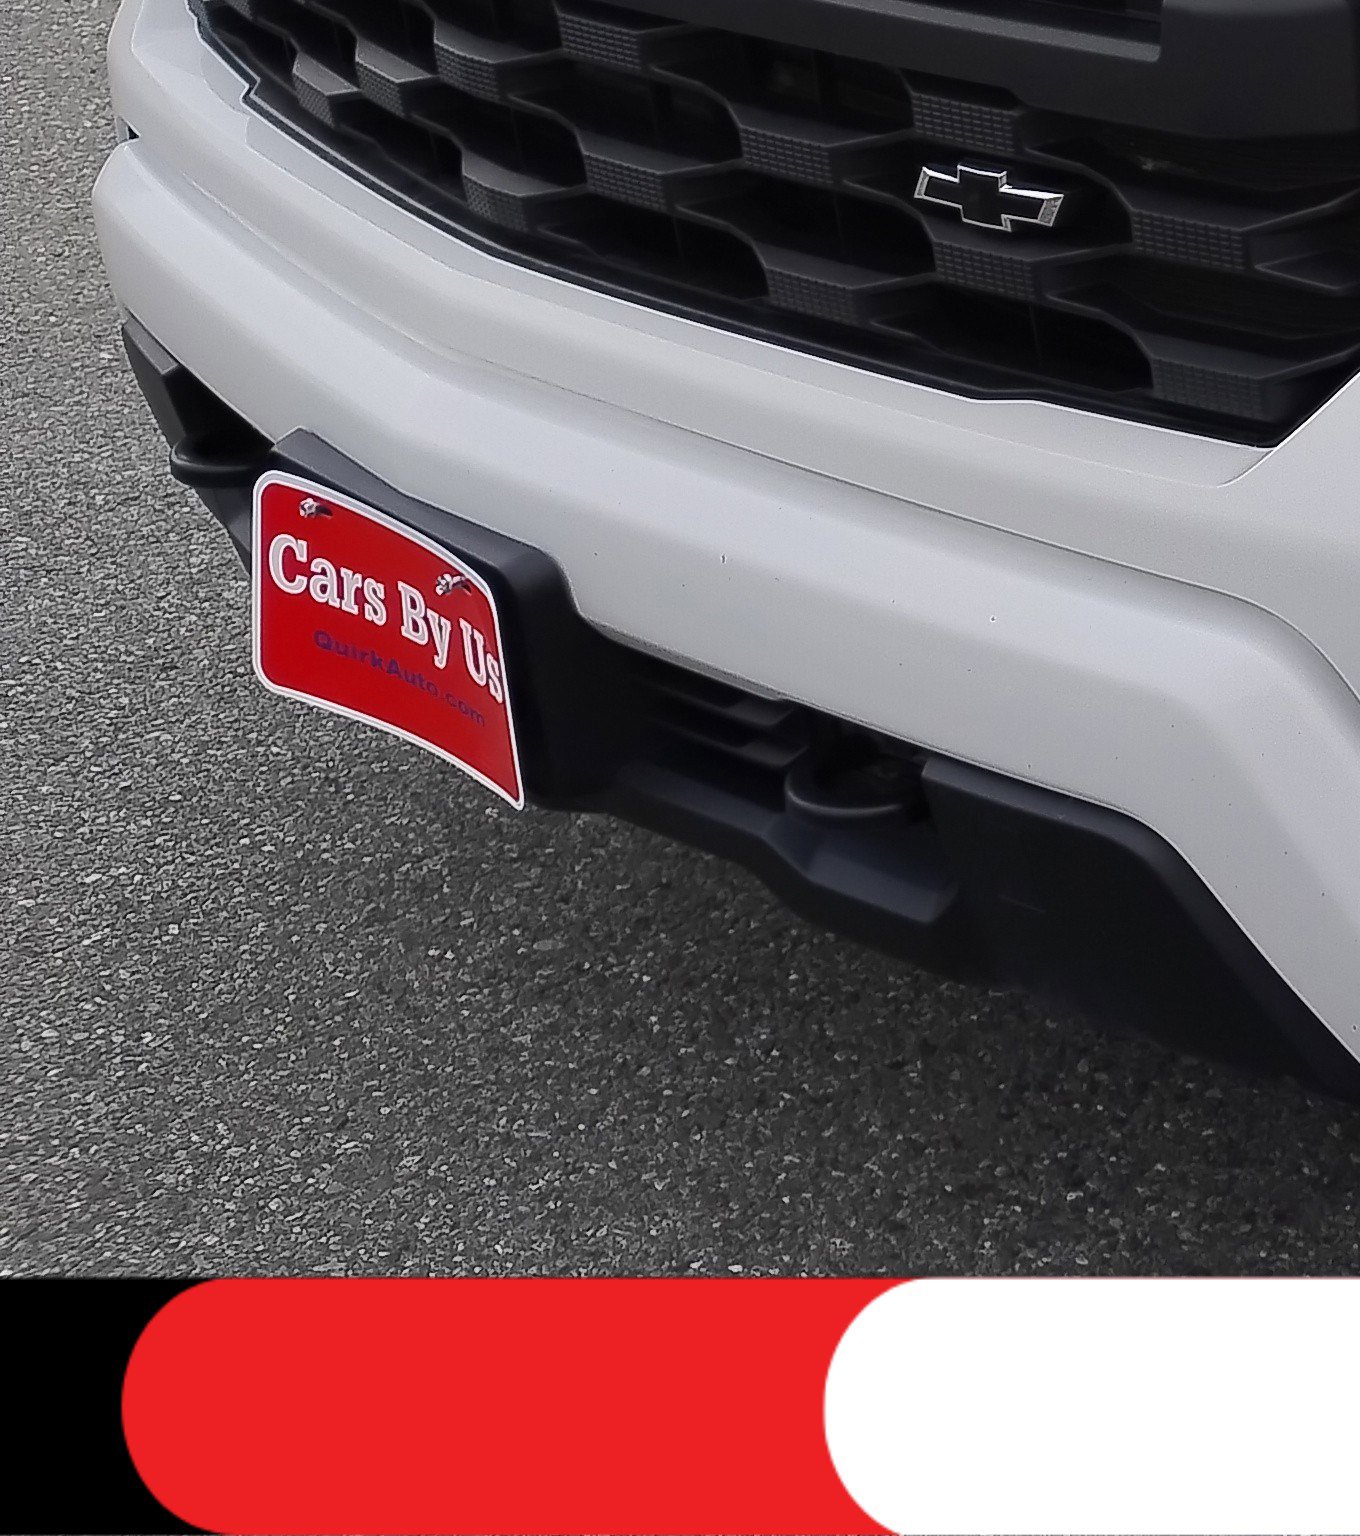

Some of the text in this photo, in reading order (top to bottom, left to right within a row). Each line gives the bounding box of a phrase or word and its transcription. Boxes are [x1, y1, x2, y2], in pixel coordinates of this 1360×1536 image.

[268, 533, 504, 704] Cars By Us
